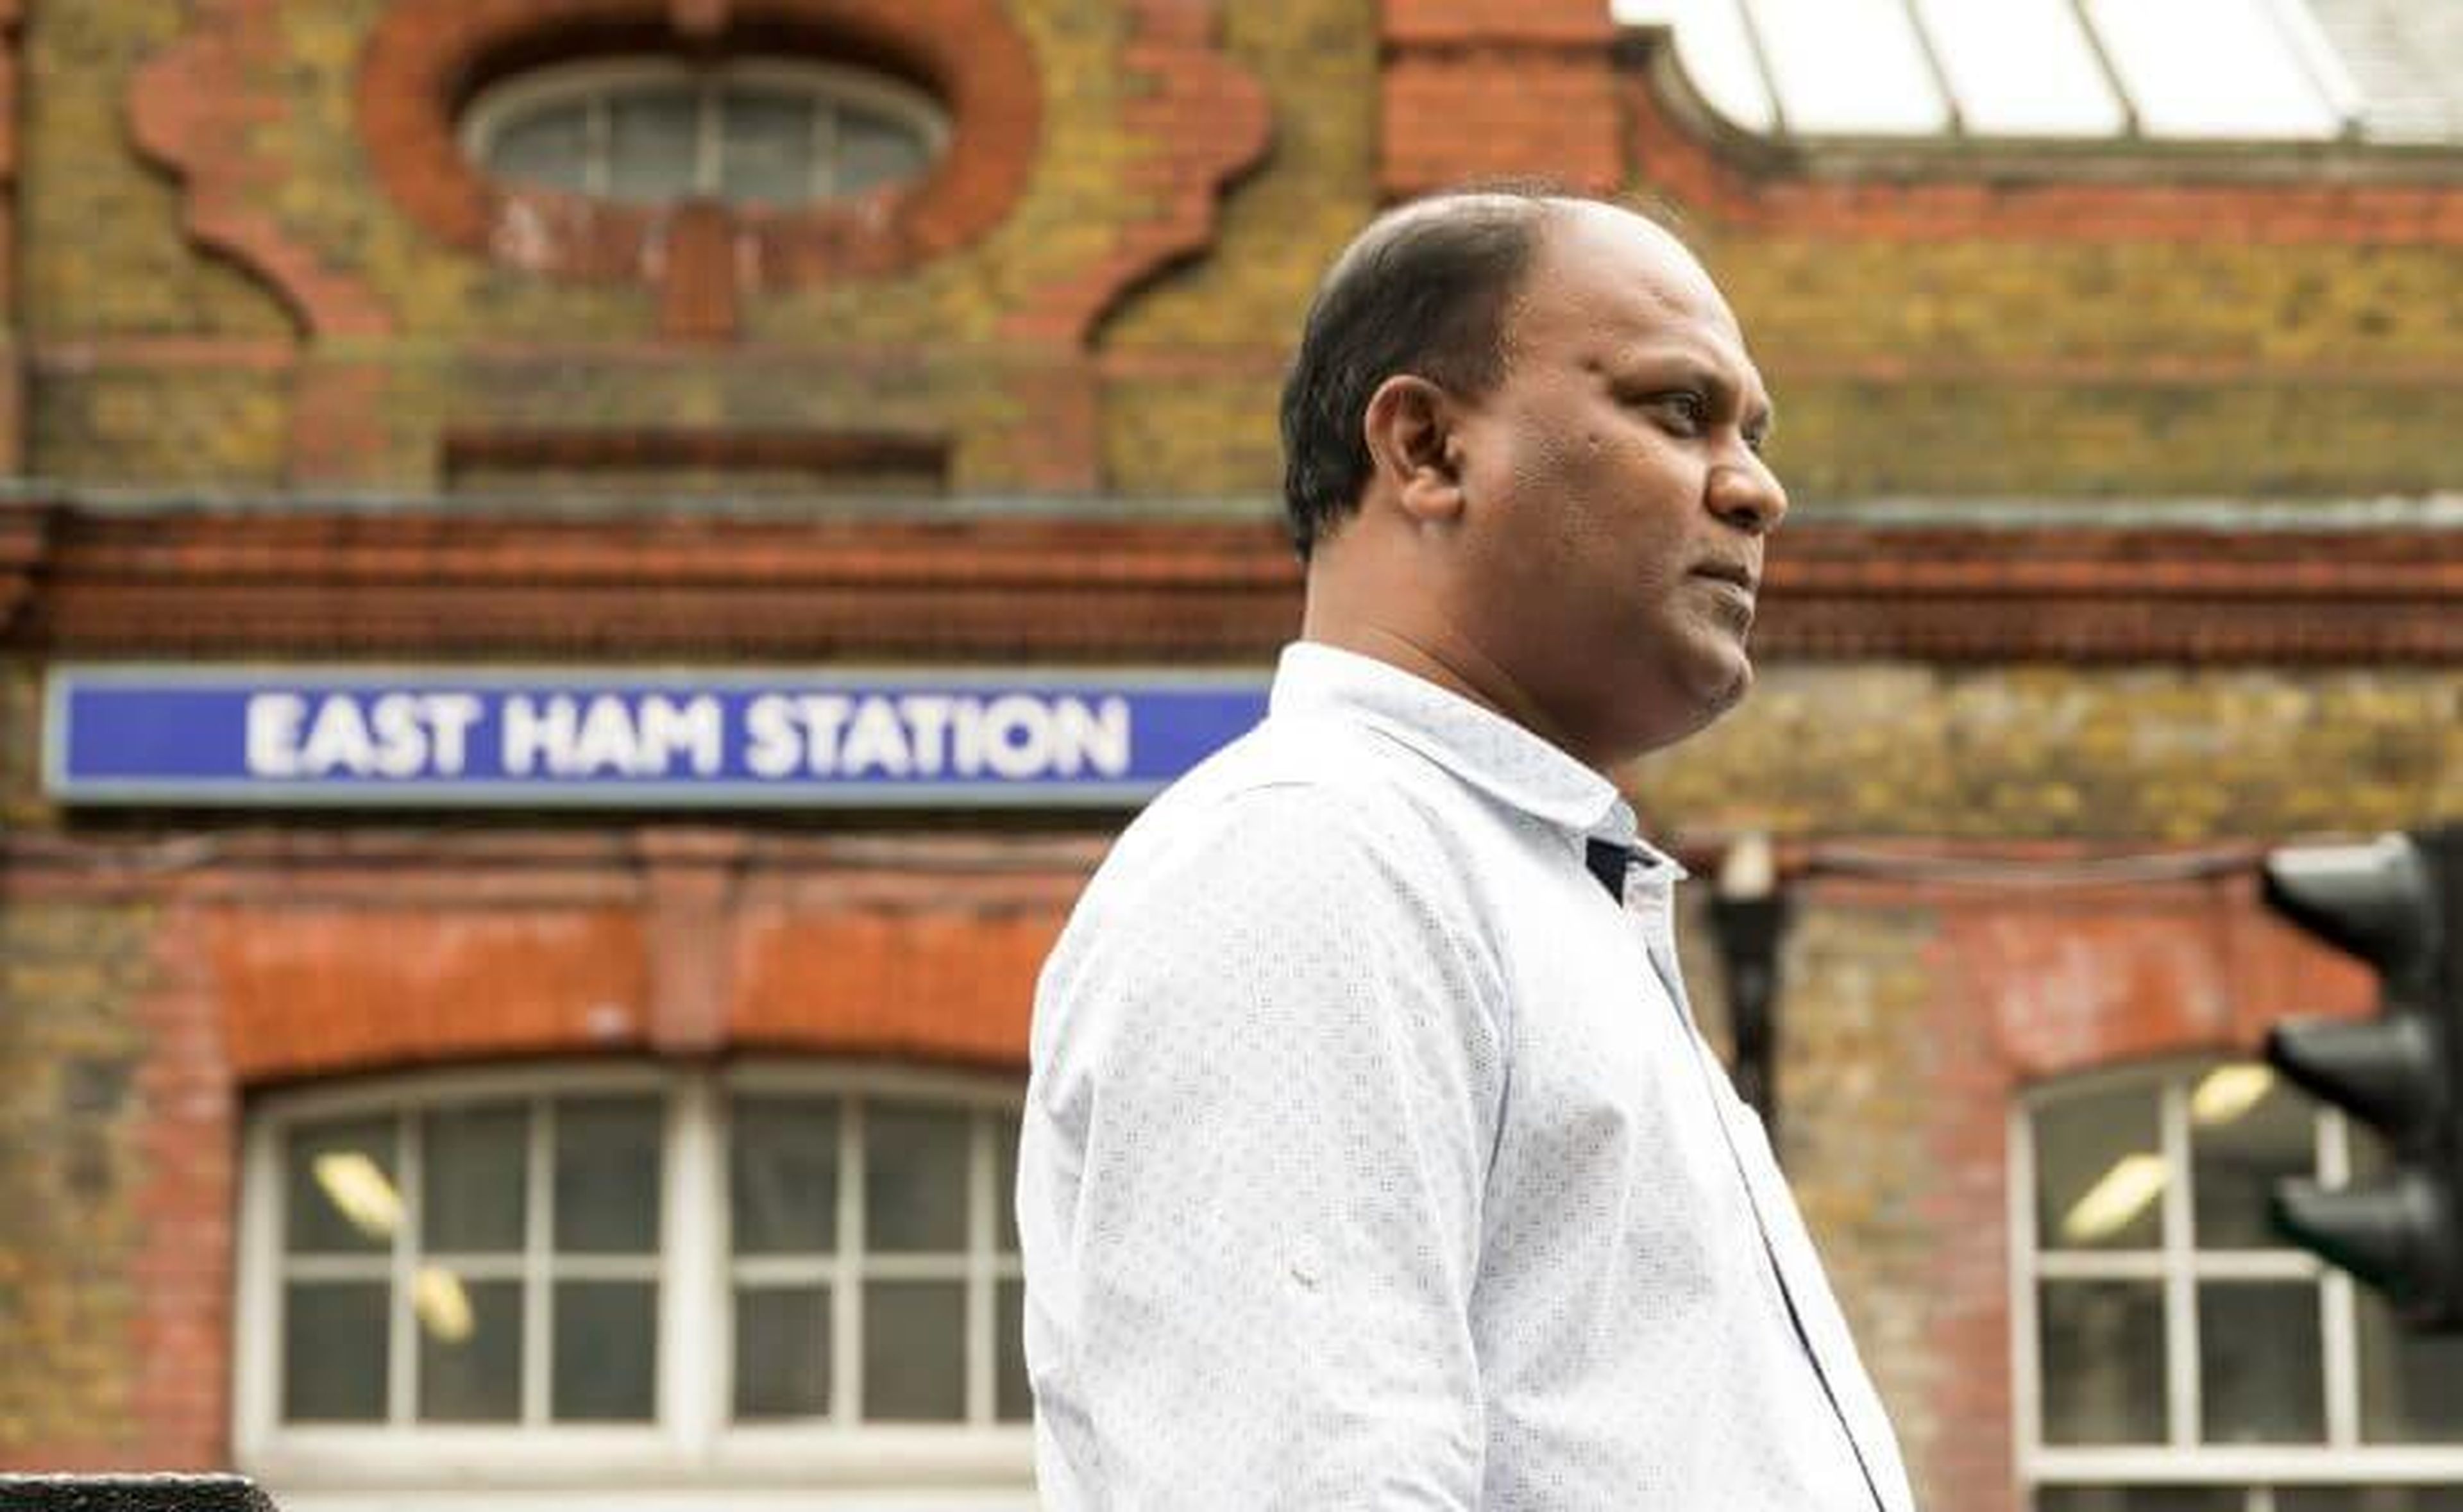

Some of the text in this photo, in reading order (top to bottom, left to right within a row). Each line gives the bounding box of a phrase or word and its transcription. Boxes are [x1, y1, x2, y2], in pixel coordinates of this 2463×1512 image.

[247, 694, 1129, 778] EAST HAM STATION
